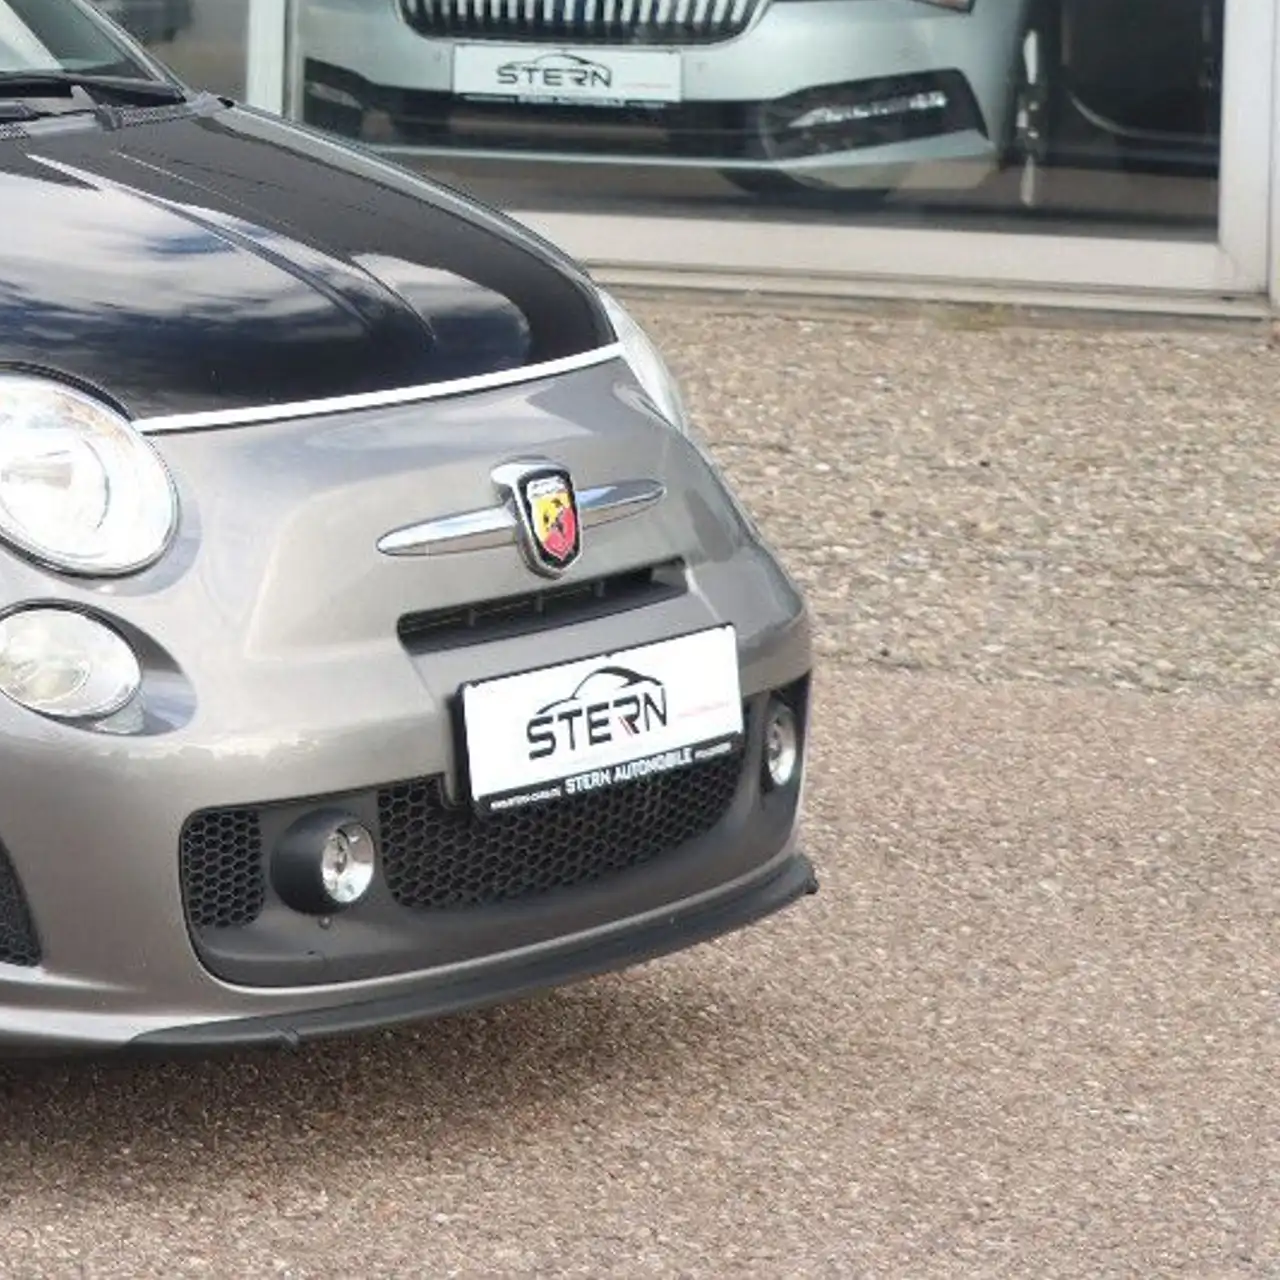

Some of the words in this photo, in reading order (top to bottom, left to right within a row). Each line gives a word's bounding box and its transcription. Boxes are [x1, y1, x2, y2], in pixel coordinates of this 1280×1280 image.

[497, 64, 613, 88] STERN
[526, 686, 668, 760] STERN
[564, 767, 612, 794] STERN
[613, 747, 692, 781] AUTOMOBILE
